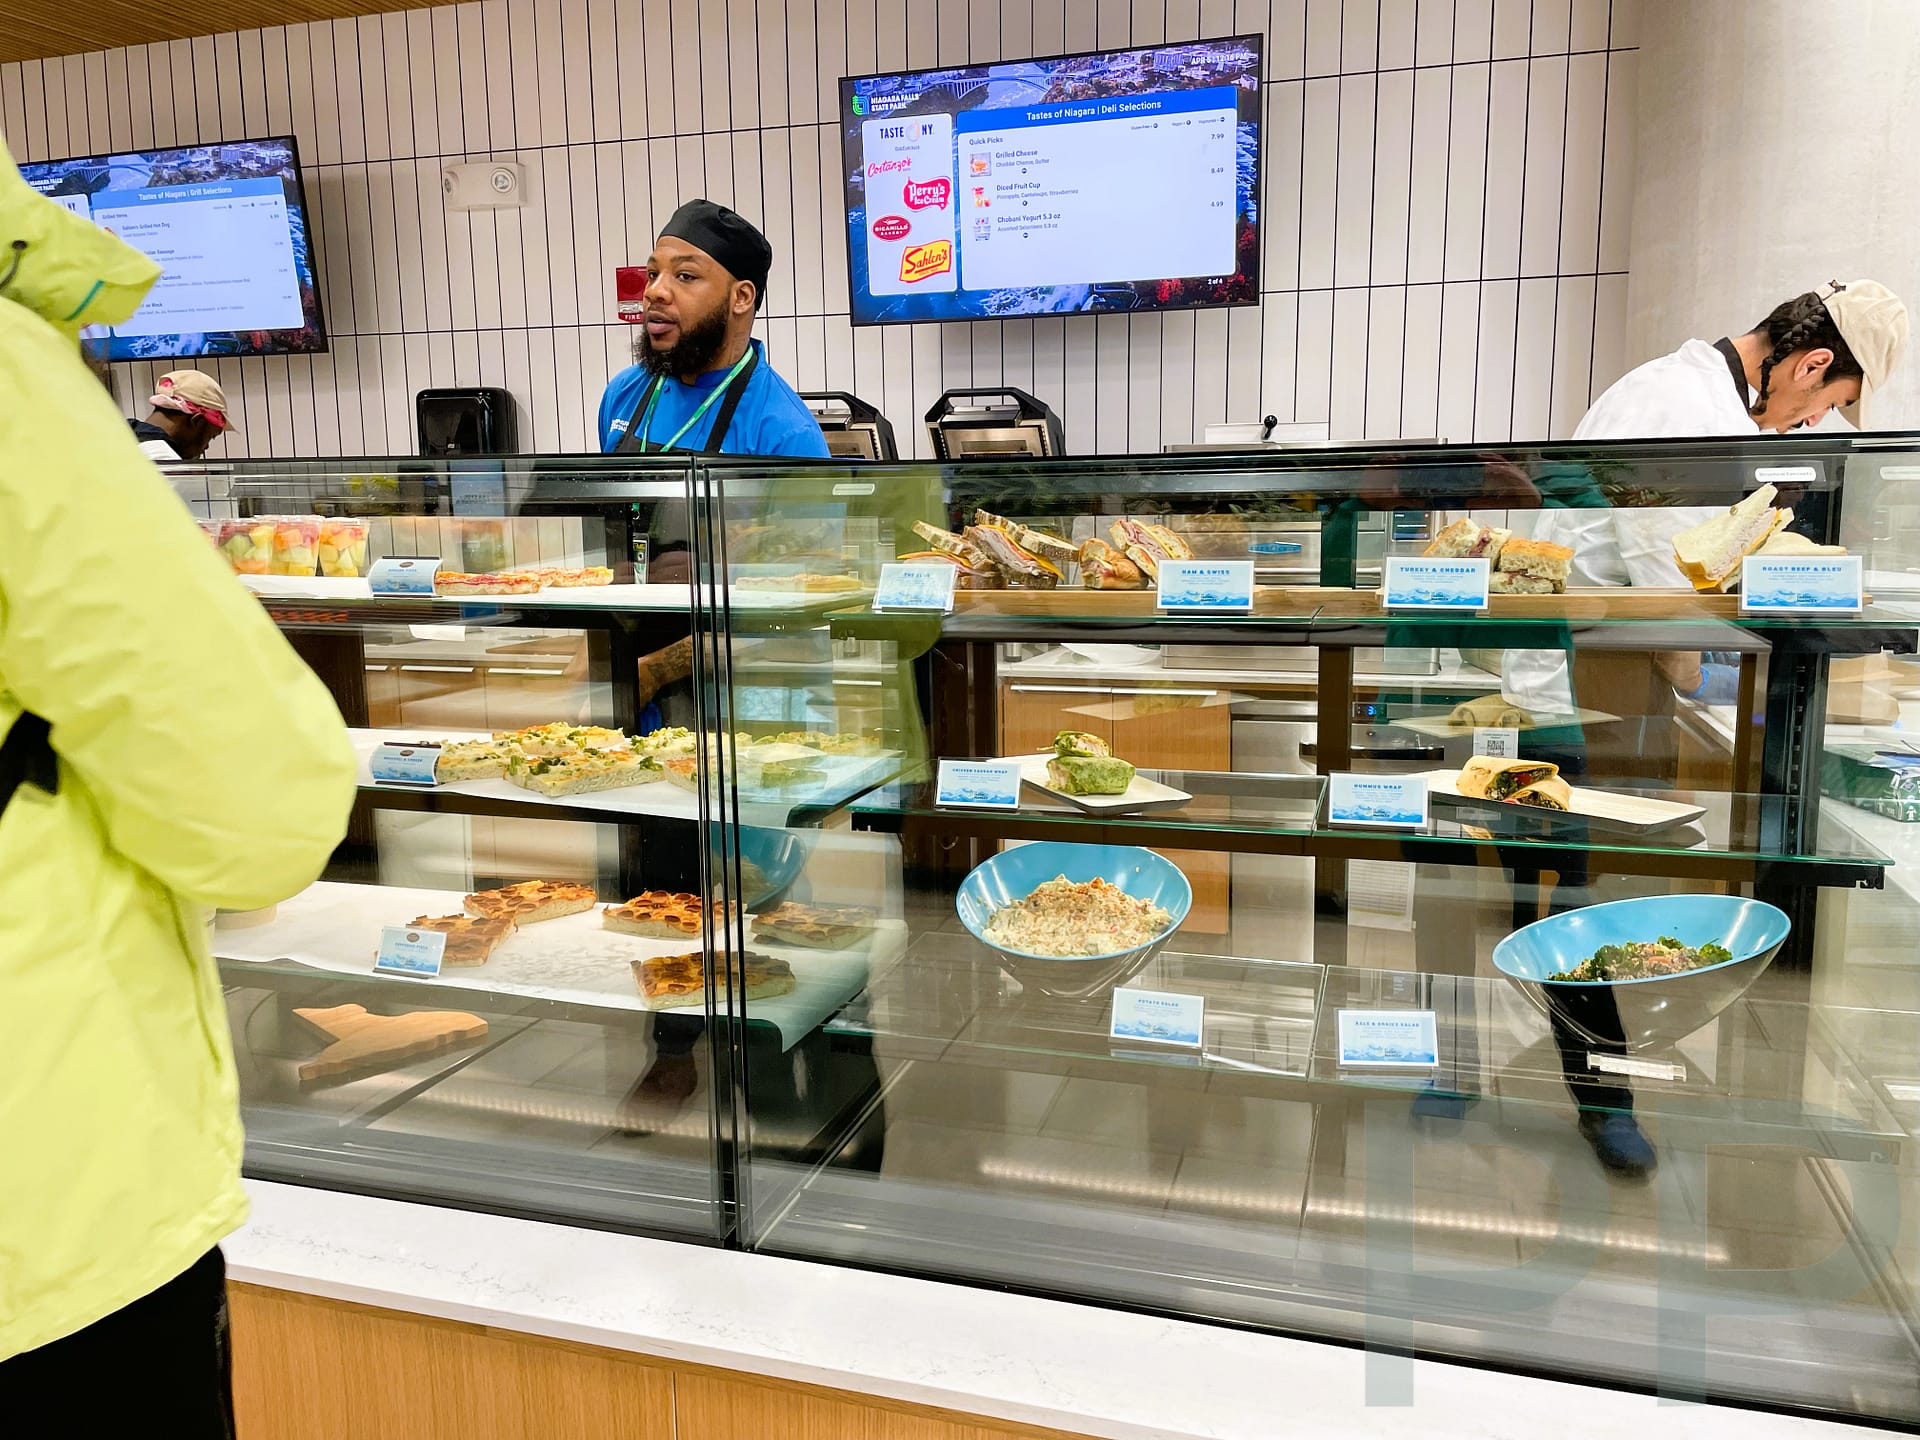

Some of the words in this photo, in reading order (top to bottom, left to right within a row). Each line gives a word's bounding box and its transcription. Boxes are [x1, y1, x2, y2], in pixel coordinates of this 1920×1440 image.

[871, 95, 900, 104] NIAGARA
[901, 93, 920, 101] FALLS
[890, 102, 907, 110] PARK
[1027, 112, 1052, 121] Tastes
[1054, 110, 1063, 118] of
[1064, 107, 1095, 118] Niagara
[1101, 103, 1117, 114] Deli
[1119, 101, 1162, 112] Selections
[880, 127, 904, 139] TASTE
[922, 124, 933, 135] NY
[908, 183, 945, 202] Perry's
[1022, 214, 1042, 222] Yogurt
[905, 247, 947, 274] Sahlen's
